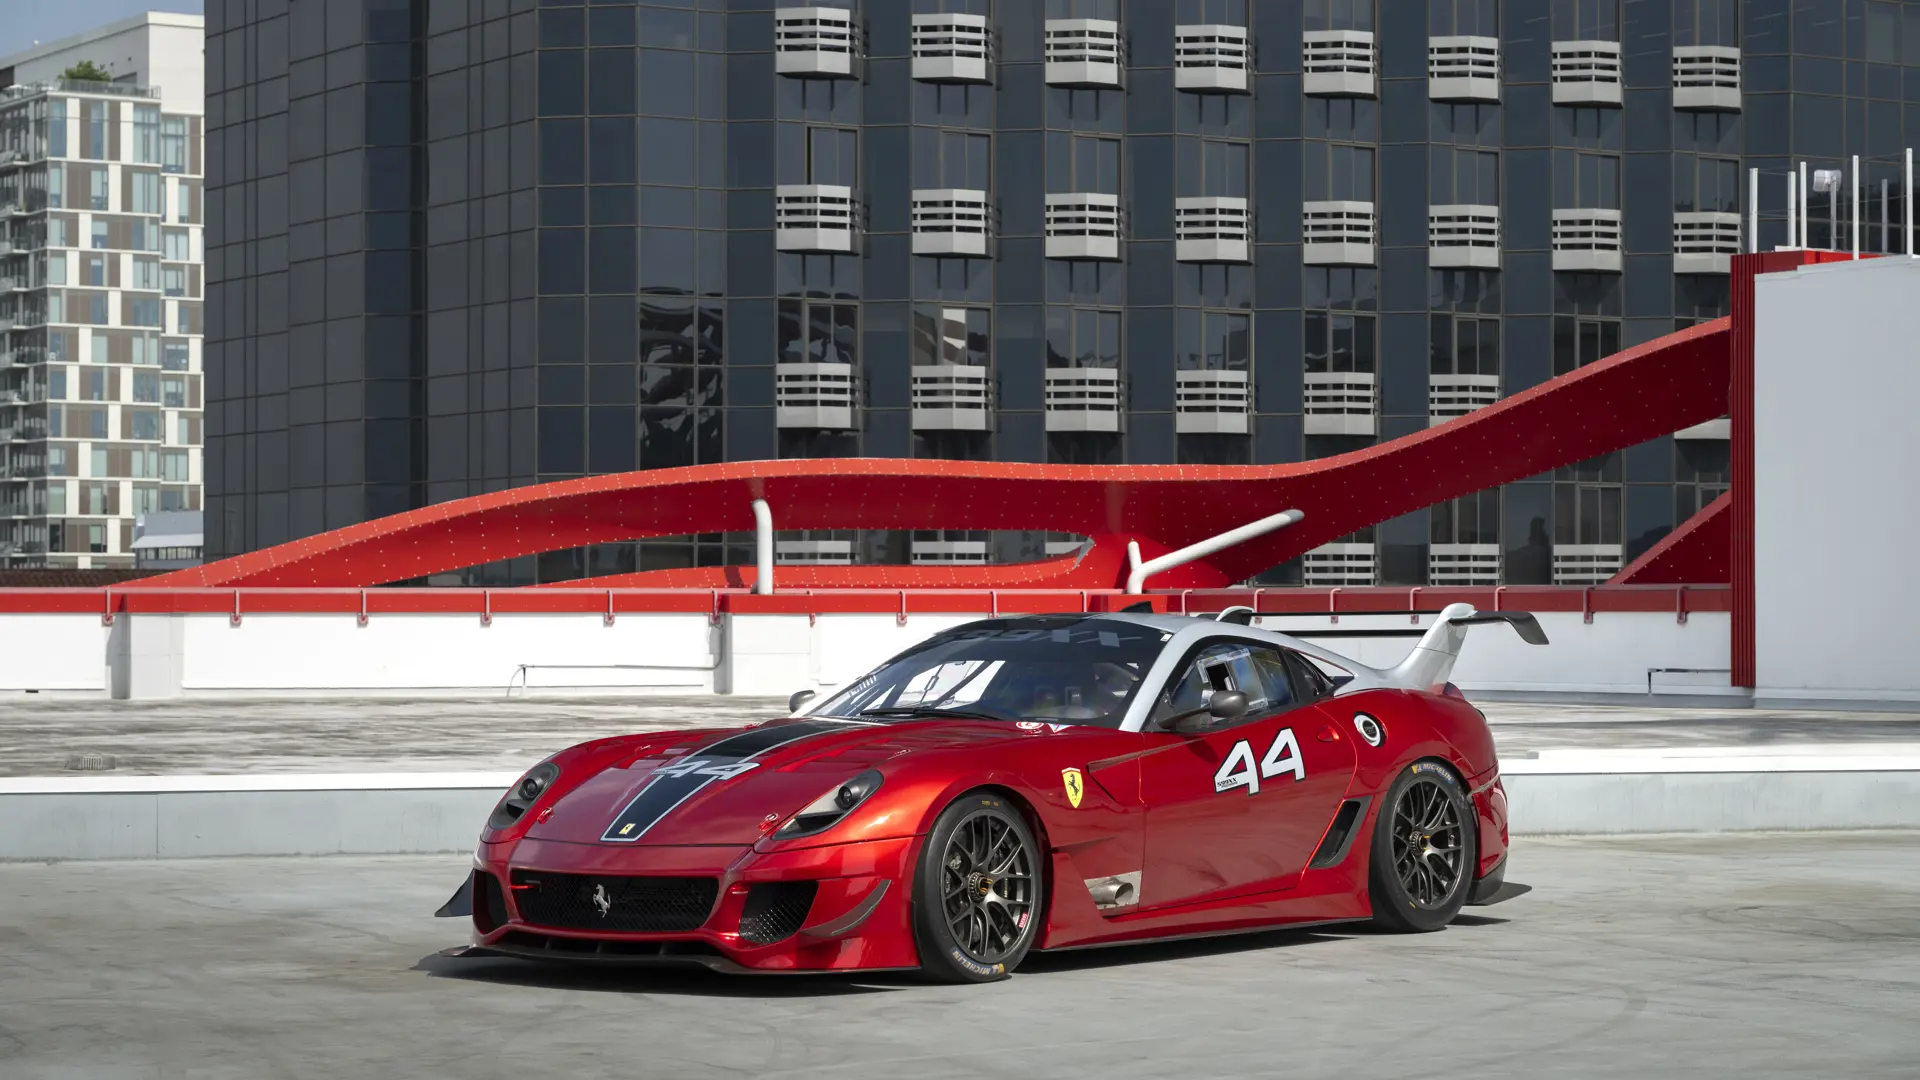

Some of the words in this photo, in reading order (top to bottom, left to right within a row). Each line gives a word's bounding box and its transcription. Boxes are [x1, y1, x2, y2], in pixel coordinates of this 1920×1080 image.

[651, 760, 761, 780] 44
[1214, 727, 1306, 796] 44
[952, 951, 991, 975] MICHELIN
